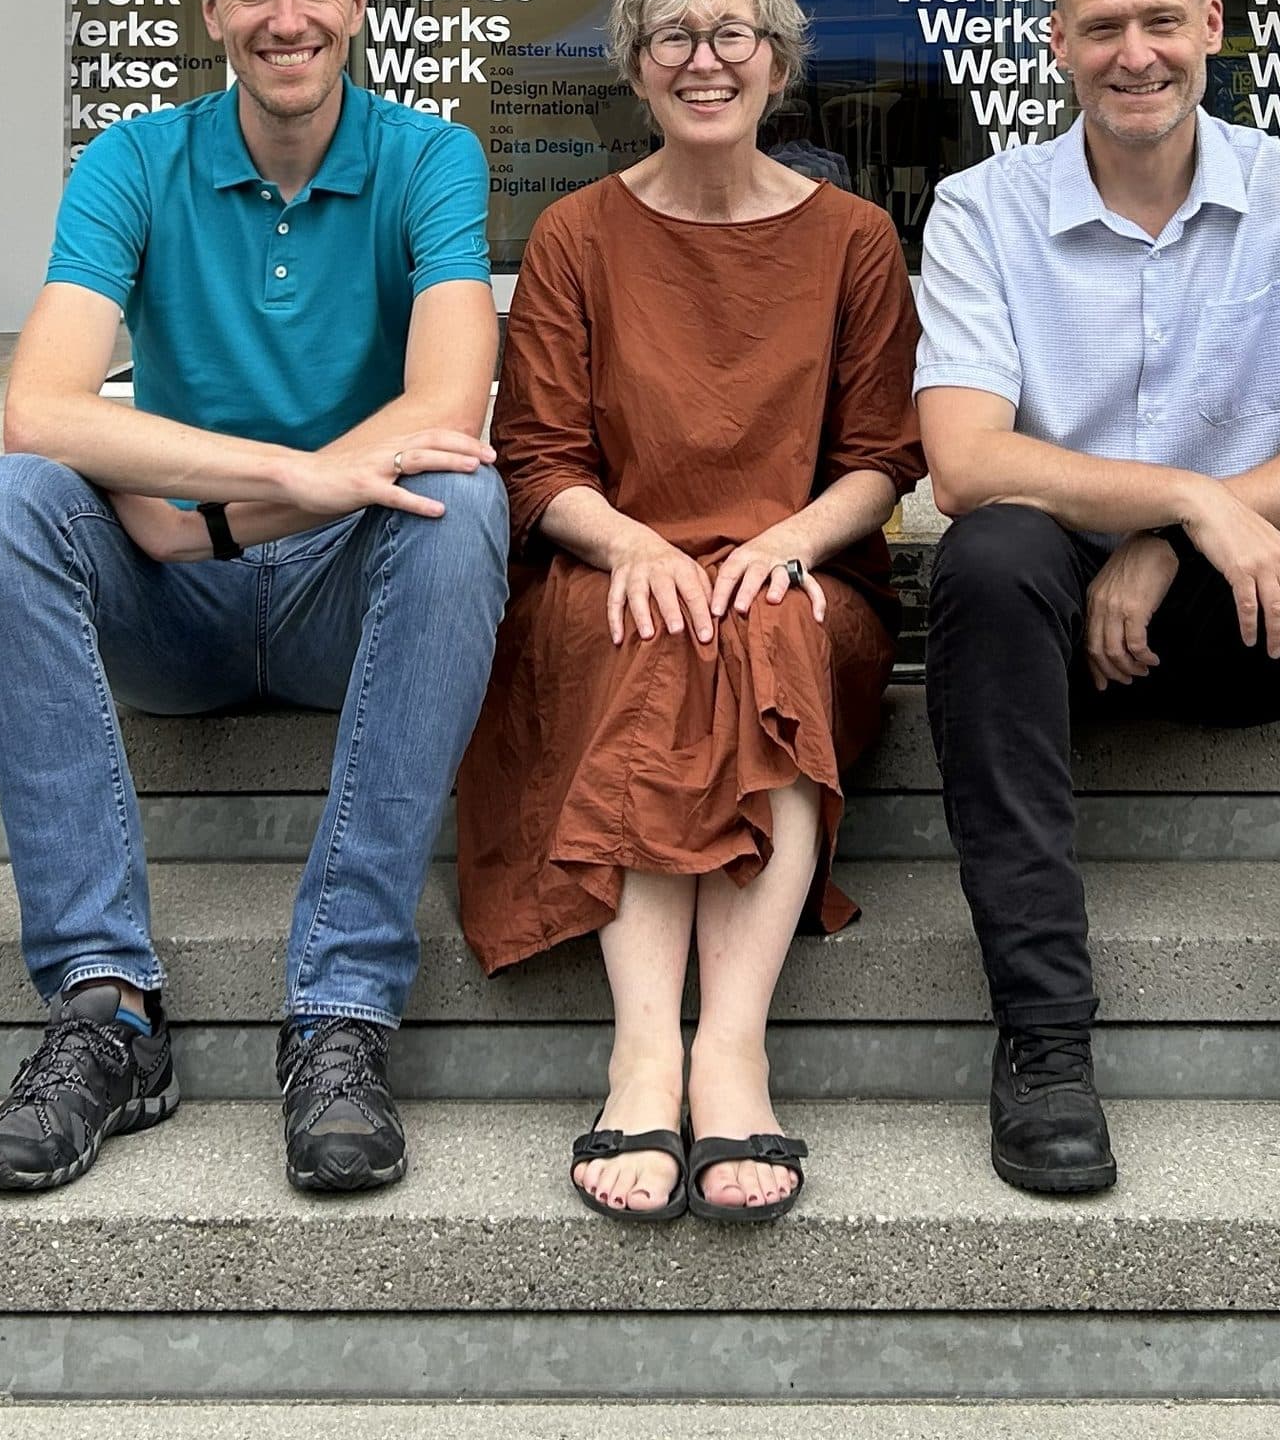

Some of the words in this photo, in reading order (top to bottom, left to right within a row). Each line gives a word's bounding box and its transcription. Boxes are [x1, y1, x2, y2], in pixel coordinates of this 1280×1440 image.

[71, 11, 179, 47] erks
[368, 7, 511, 43] Werks
[490, 43, 552, 58] Master
[556, 43, 604, 58] Kunst
[368, 48, 487, 83] Werk
[490, 67, 513, 76] 2.OG
[943, 49, 1065, 85] Werk
[490, 81, 548, 99] Design
[490, 100, 599, 115] International
[970, 90, 1065, 126] Wer
[490, 126, 513, 134] 3.OG
[490, 139, 530, 153] Data
[535, 139, 594, 157] Design
[611, 140, 637, 153] Art
[491, 178, 545, 196] Digital
